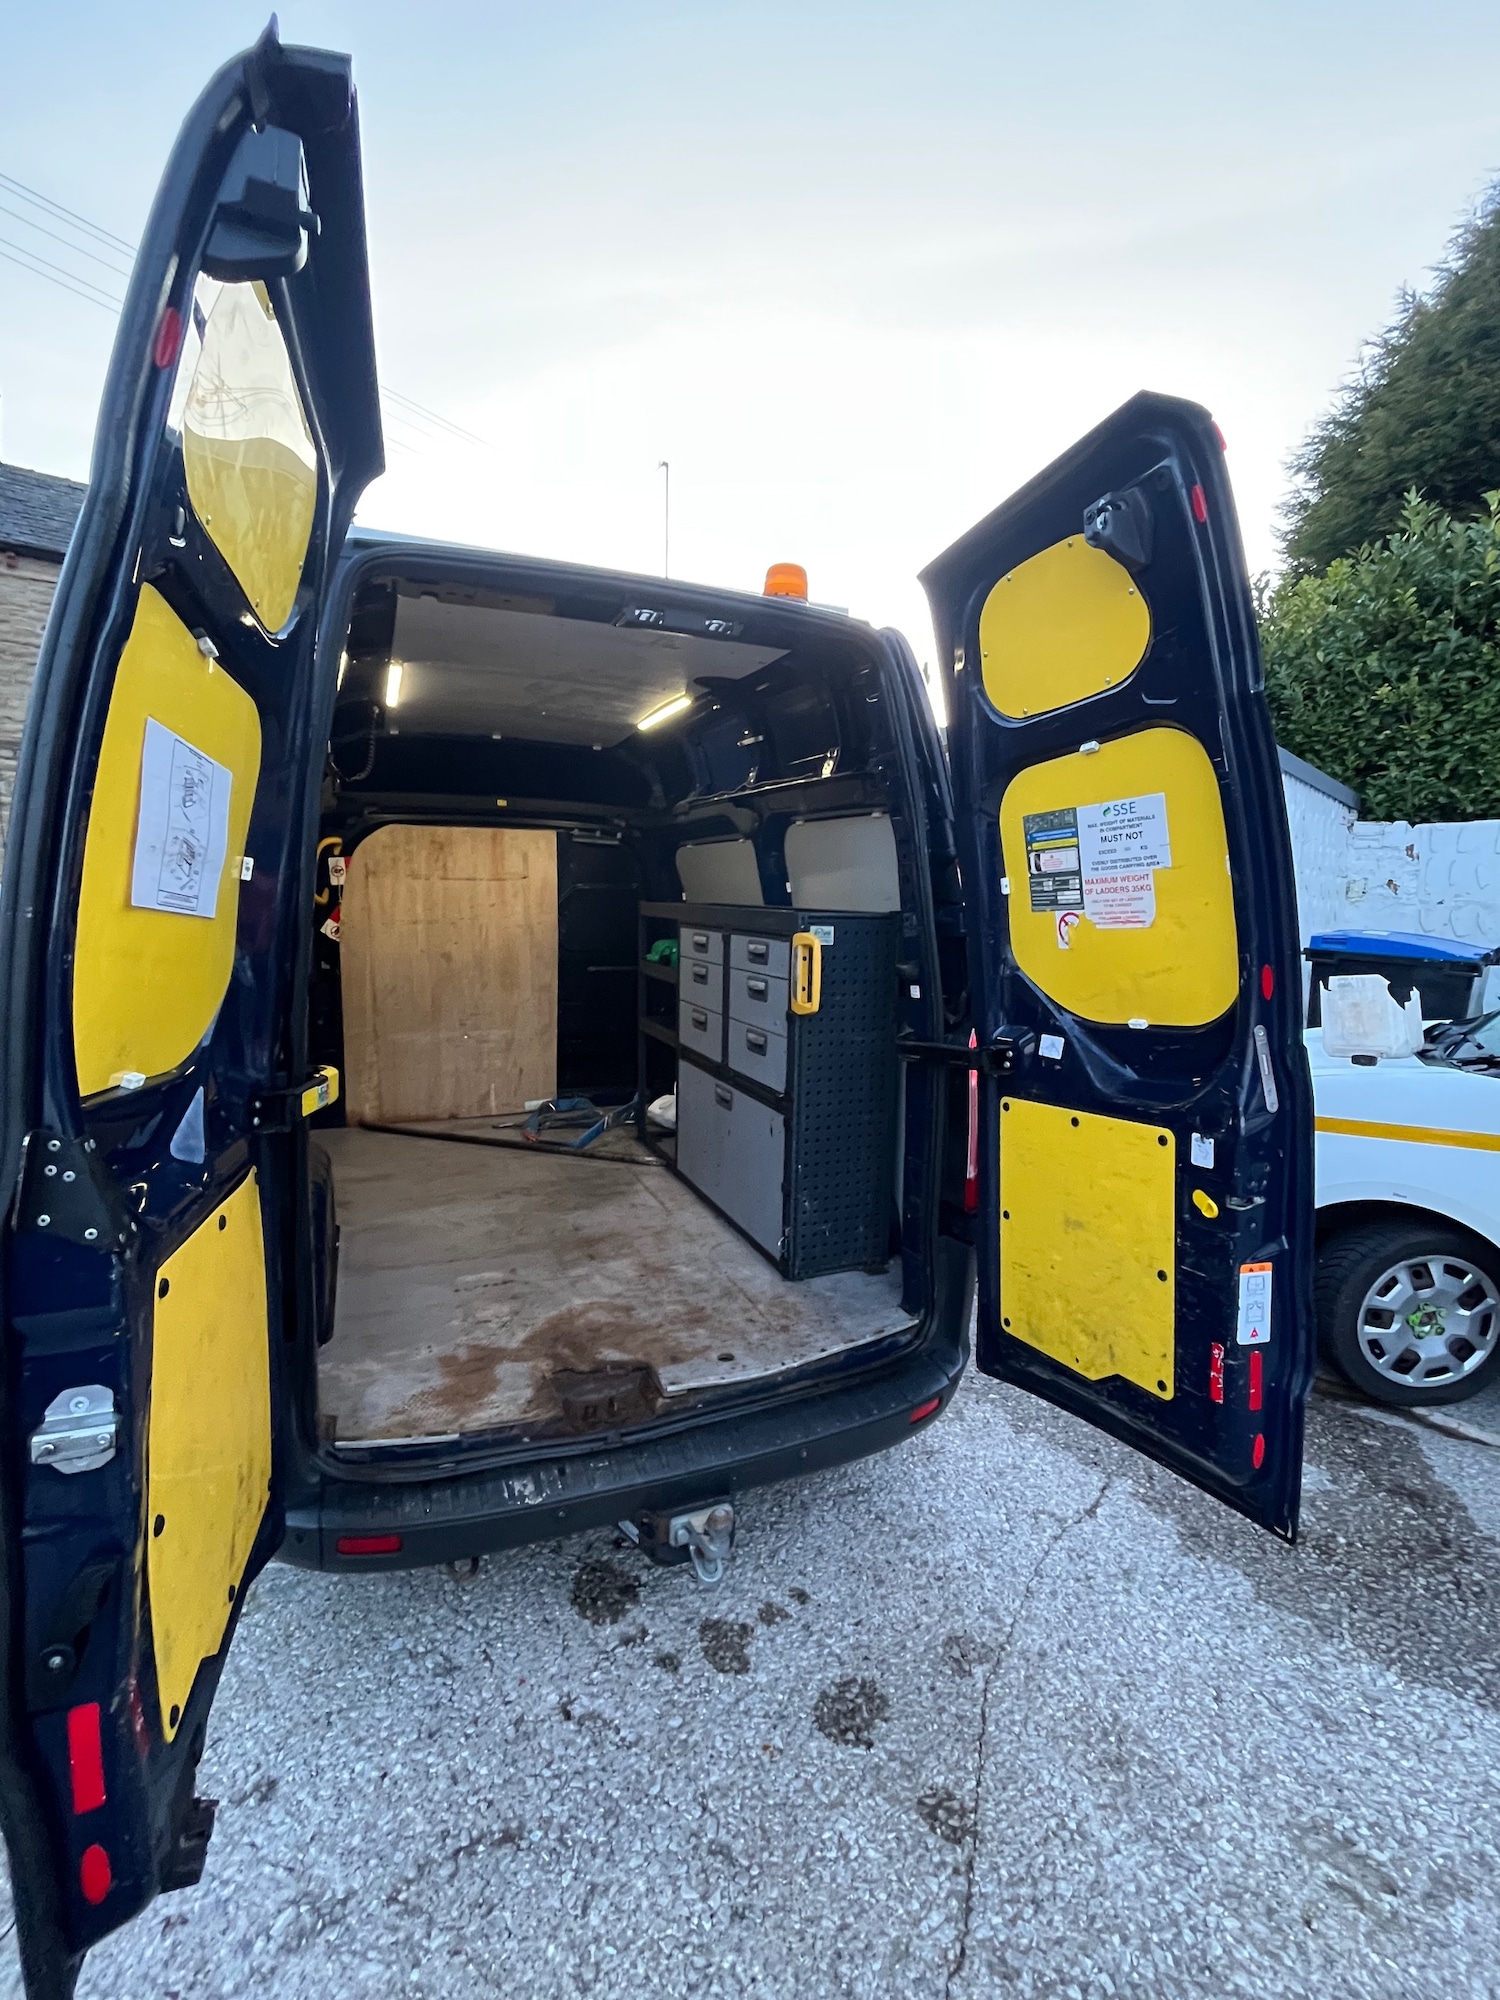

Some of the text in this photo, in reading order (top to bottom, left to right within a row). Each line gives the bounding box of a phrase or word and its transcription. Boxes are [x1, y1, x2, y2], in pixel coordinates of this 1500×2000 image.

[1112, 802, 1137, 816] SSE
[1127, 814, 1155, 823] MATERIALS
[1105, 823, 1143, 832] COMPARTMENT
[1100, 831, 1144, 844] MUST NOT
[1084, 874, 1149, 885] MAXIMUM WEIGHT
[1096, 886, 1131, 894] LADDERS
[1132, 884, 1152, 892] 35KG
